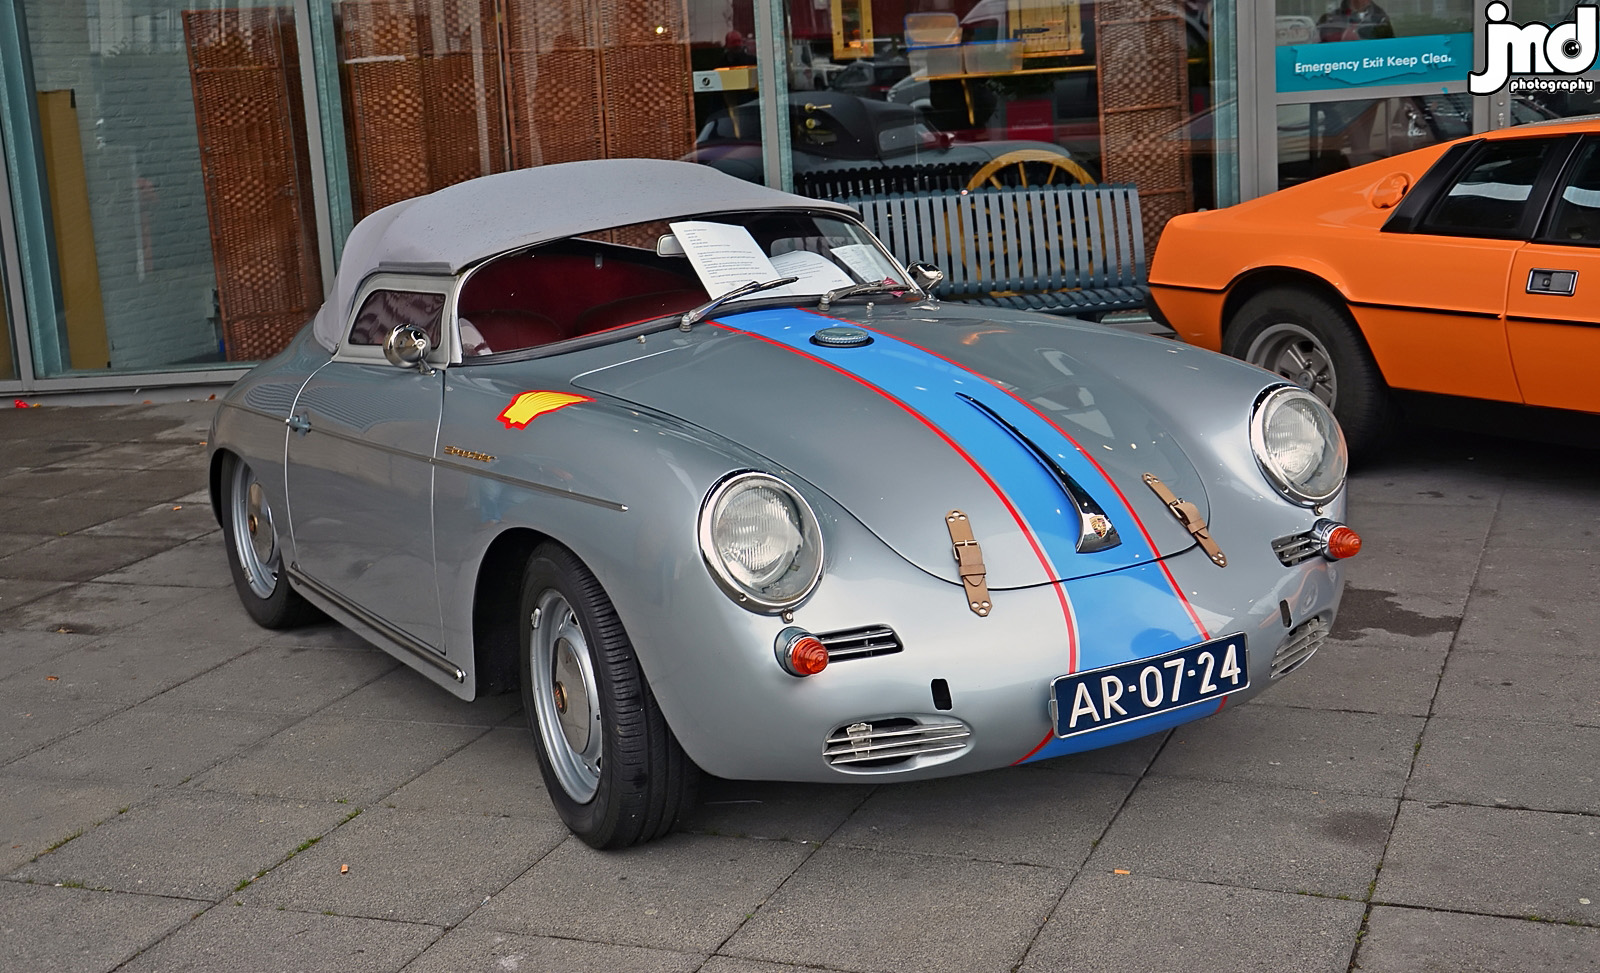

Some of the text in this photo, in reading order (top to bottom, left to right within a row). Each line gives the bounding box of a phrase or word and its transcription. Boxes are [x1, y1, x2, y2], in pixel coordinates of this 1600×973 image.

[1295, 60, 1359, 75] Emergency
[1362, 56, 1384, 69] Exit
[1387, 55, 1418, 70] Keep
